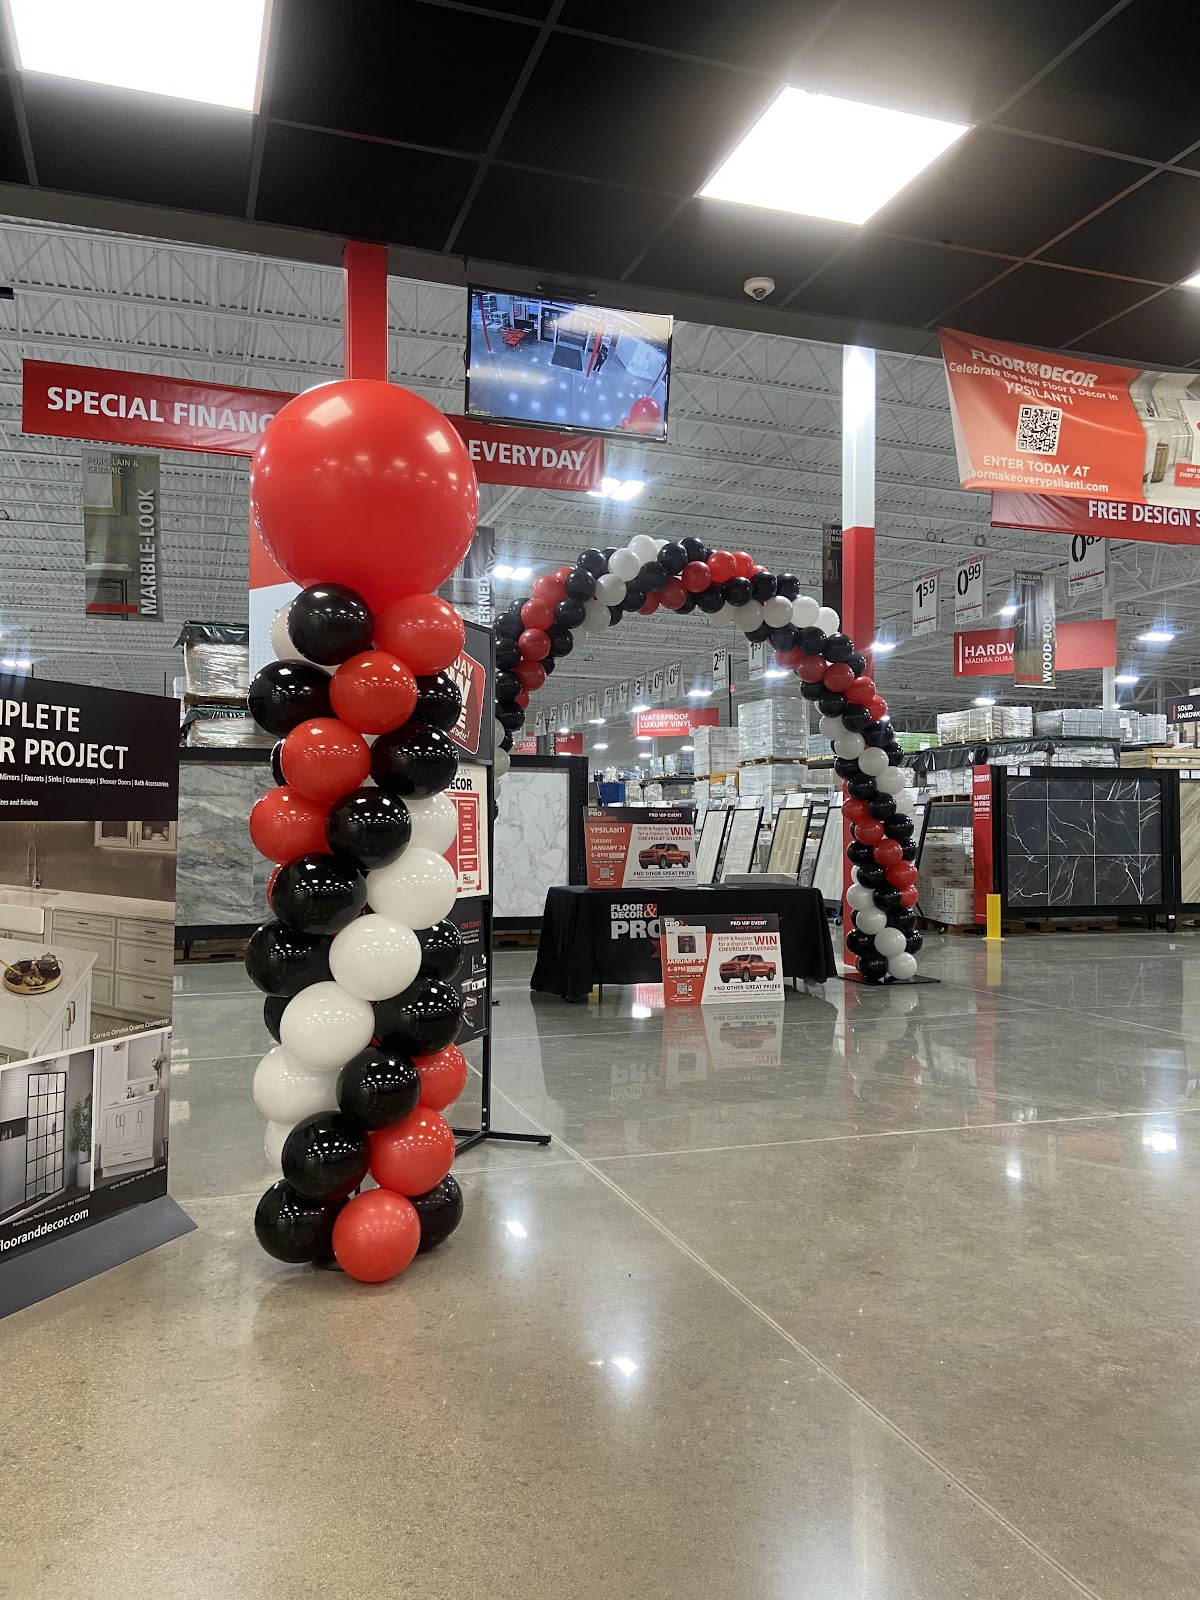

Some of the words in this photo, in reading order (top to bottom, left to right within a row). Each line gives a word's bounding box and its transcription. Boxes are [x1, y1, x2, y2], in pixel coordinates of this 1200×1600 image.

[970, 348, 1026, 374] FLOOR
[1039, 364, 1098, 388] DECOR
[949, 362, 1000, 377] Celebrate
[1003, 370, 1018, 381] the
[1019, 375, 1040, 387] New
[1042, 380, 1067, 393] Floor
[1069, 387, 1077, 395] &
[1078, 388, 1106, 399] Decor
[1108, 392, 1119, 401] in
[1005, 381, 1074, 406] YPSILANTI
[47, 386, 165, 423] SPECIAL
[86, 456, 131, 468] PORCELAIN
[132, 460, 139, 468] &
[469, 439, 586, 471] EVERYDAY
[87, 466, 123, 475] CERAMIC
[983, 455, 1024, 470] ENTER
[1027, 460, 1070, 476] TODAY
[1073, 465, 1091, 478] AT
[1088, 500, 1127, 521] FREE
[1132, 504, 1191, 527] DESIGN
[138, 488, 157, 615] MARBLE-LOOK
[965, 657, 993, 665] MADERA
[1177, 704, 1194, 712] SOLID
[640, 713, 689, 721] WATERPROOF
[640, 721, 669, 729] LUXURY
[670, 720, 692, 728] VINYL
[24, 738, 129, 770] PROJECT
[24, 774, 45, 783] Faucets
[48, 775, 63, 783] Sinks
[66, 776, 96, 785] Countertops
[145, 780, 169, 788] Accessories
[20, 799, 39, 807] finishes
[670, 827, 692, 836] WIN
[611, 904, 643, 912] FLOOR
[644, 903, 657, 918] &
[611, 911, 643, 919] DECOR
[754, 935, 777, 945] WIN
[129, 1022, 144, 1032] Quartz
[145, 1018, 170, 1027] Countertop
